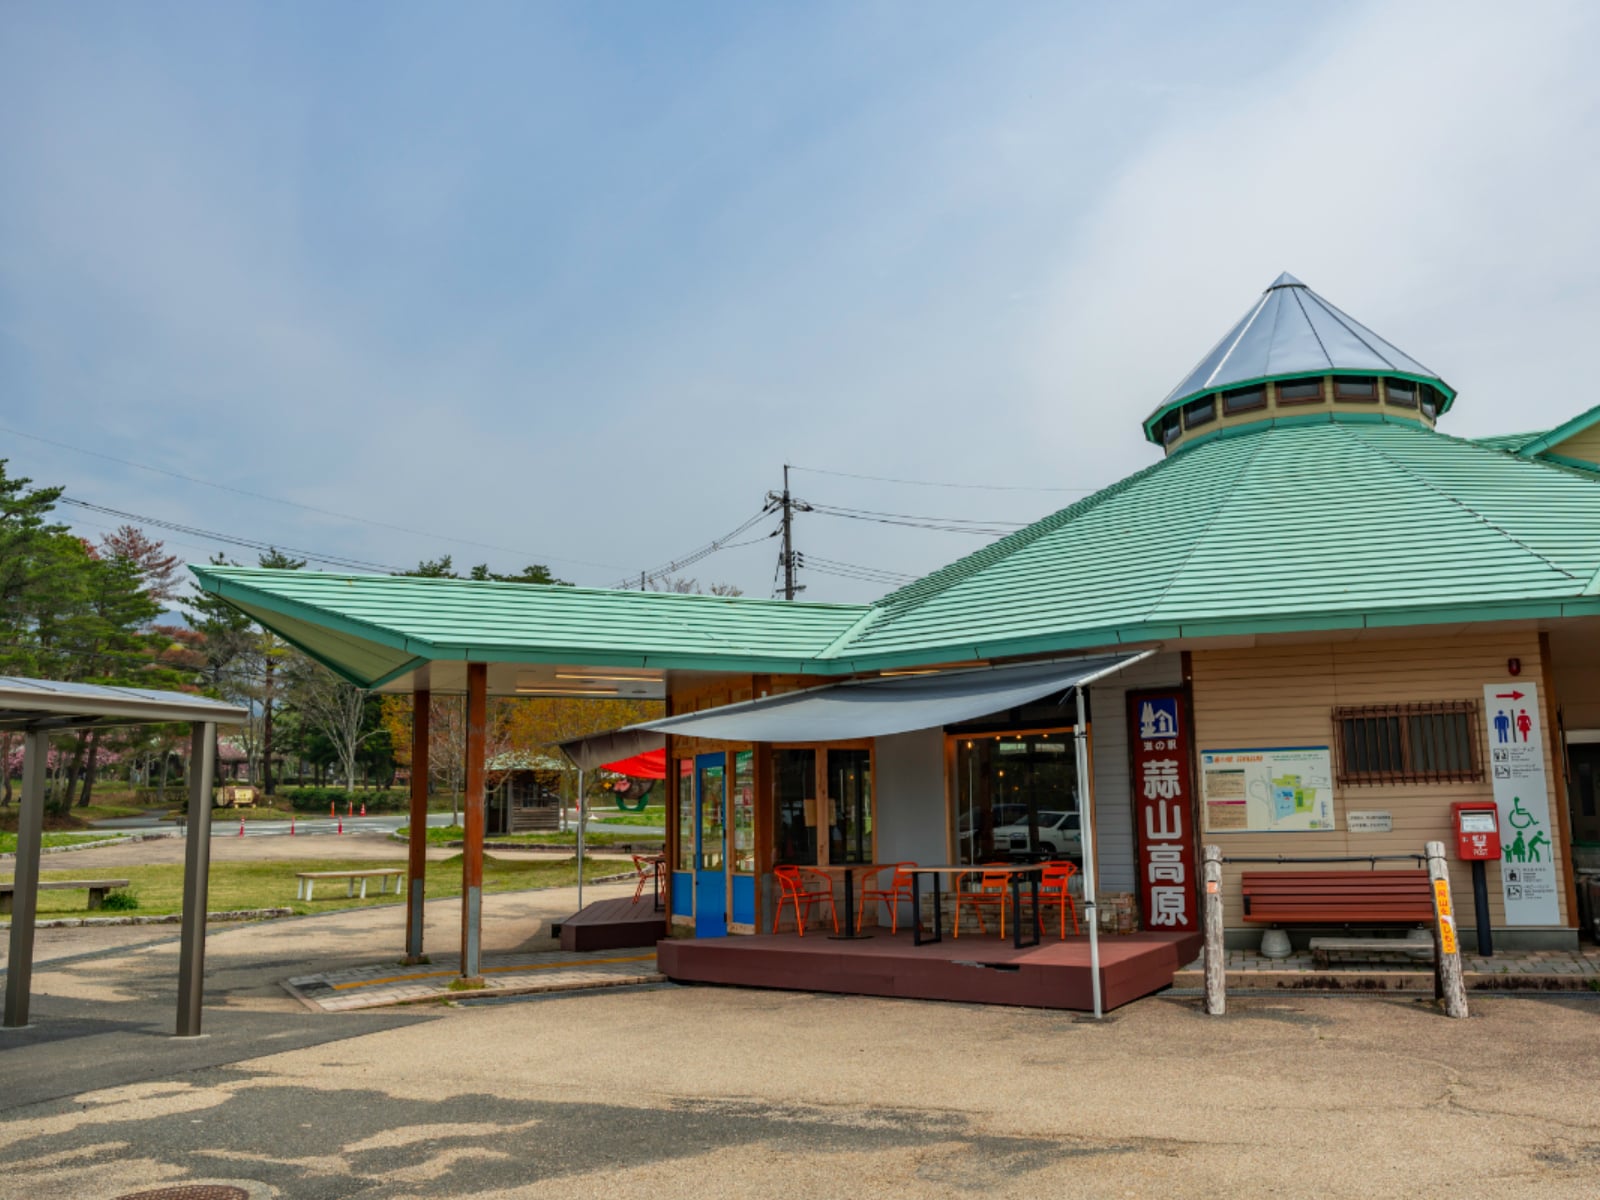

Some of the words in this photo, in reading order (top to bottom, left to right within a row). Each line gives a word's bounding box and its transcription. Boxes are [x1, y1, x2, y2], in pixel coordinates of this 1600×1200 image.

[1143, 739, 1177, 752] 道の駅
[1142, 759, 1188, 926] 蒜山高原
